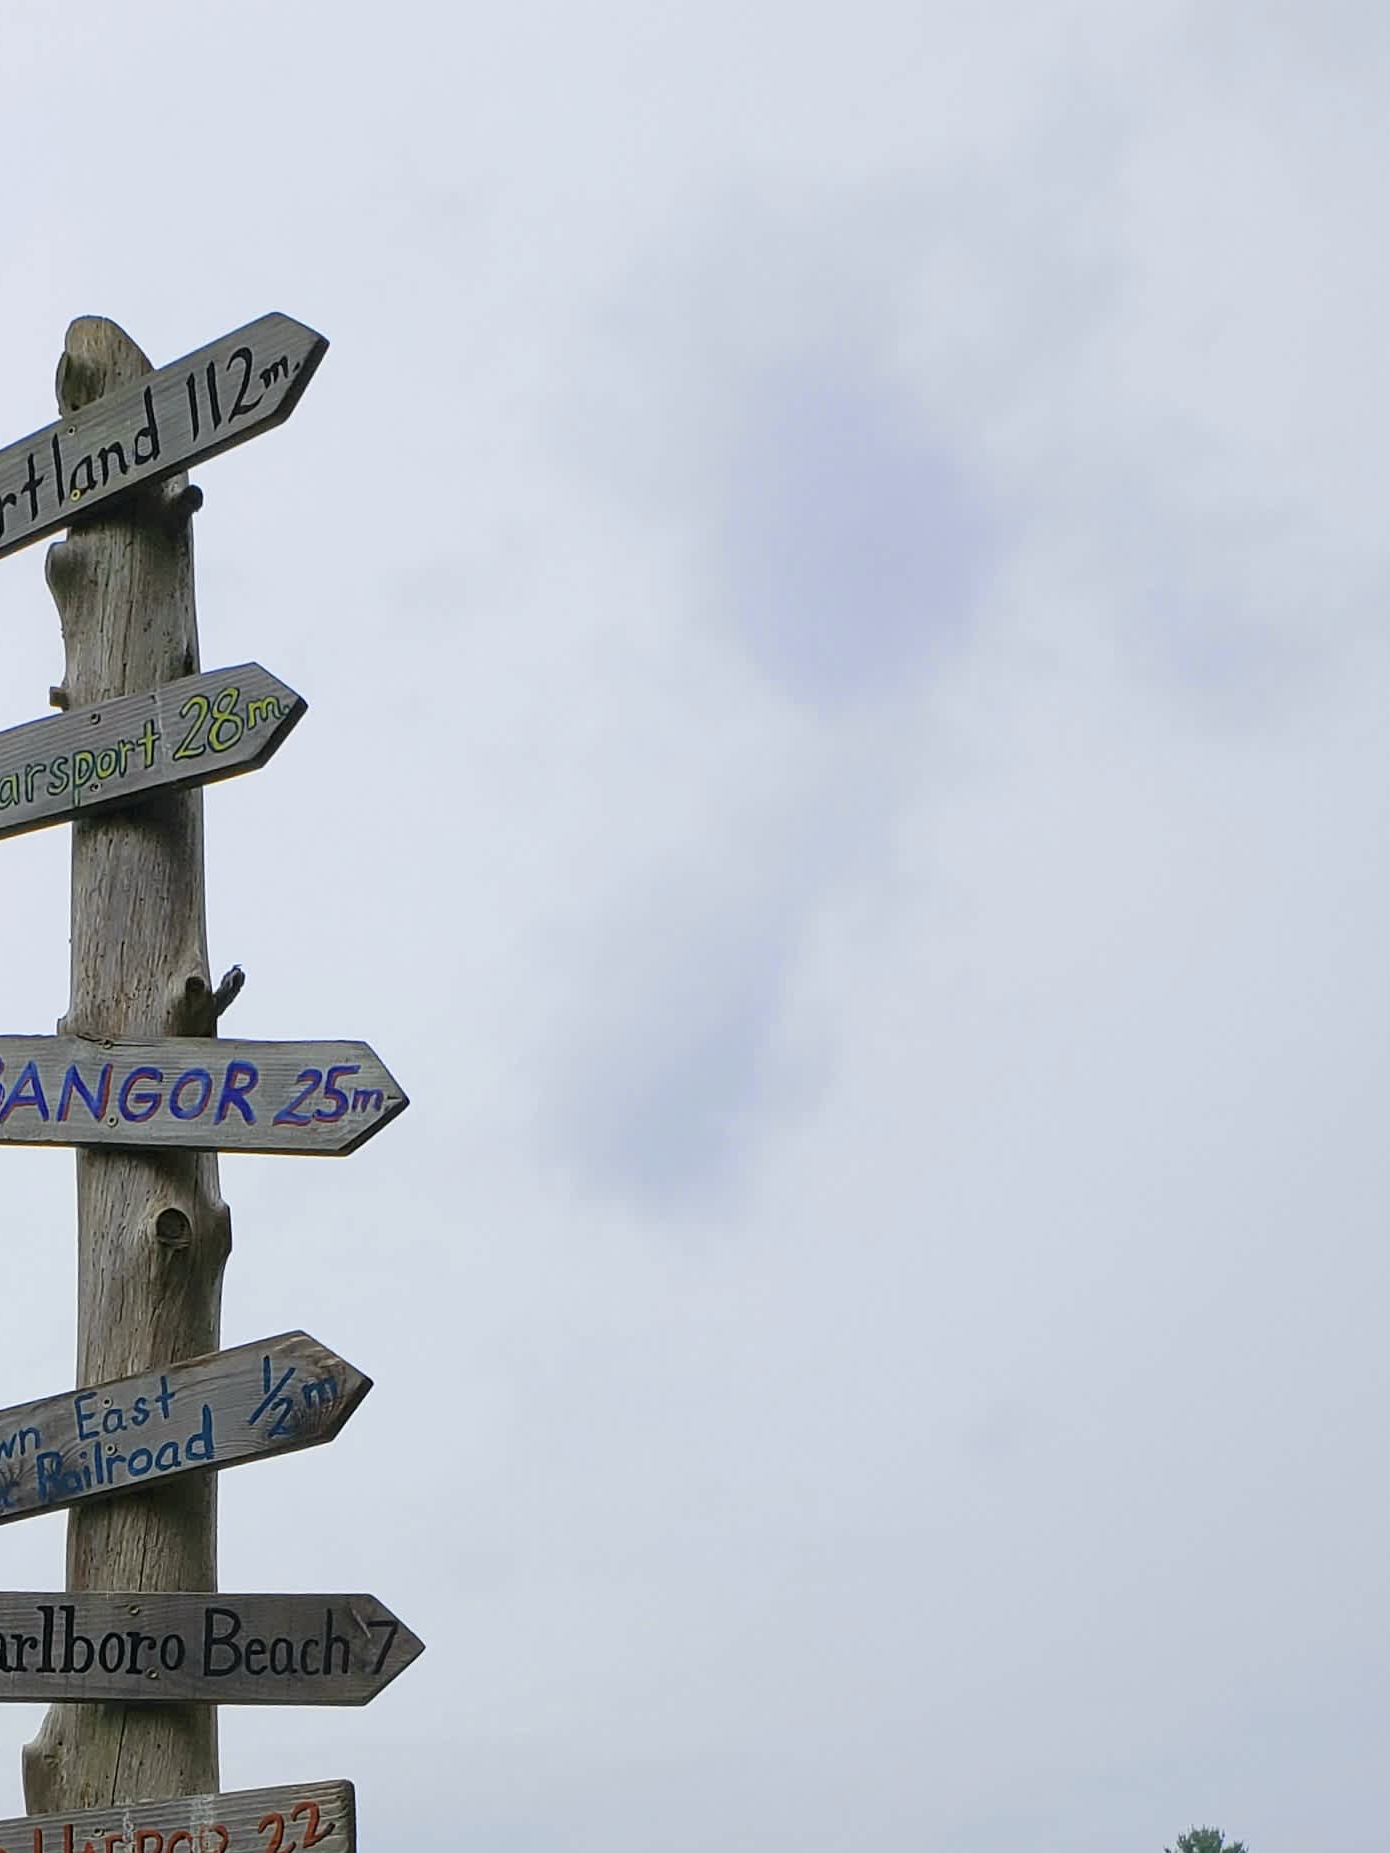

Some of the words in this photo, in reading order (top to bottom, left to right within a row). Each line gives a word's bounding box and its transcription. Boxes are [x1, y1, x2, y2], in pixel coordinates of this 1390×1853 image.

[74, 1375, 176, 1442] East
[36, 1403, 215, 1500] Railroad
[202, 1608, 350, 1679] Beach
